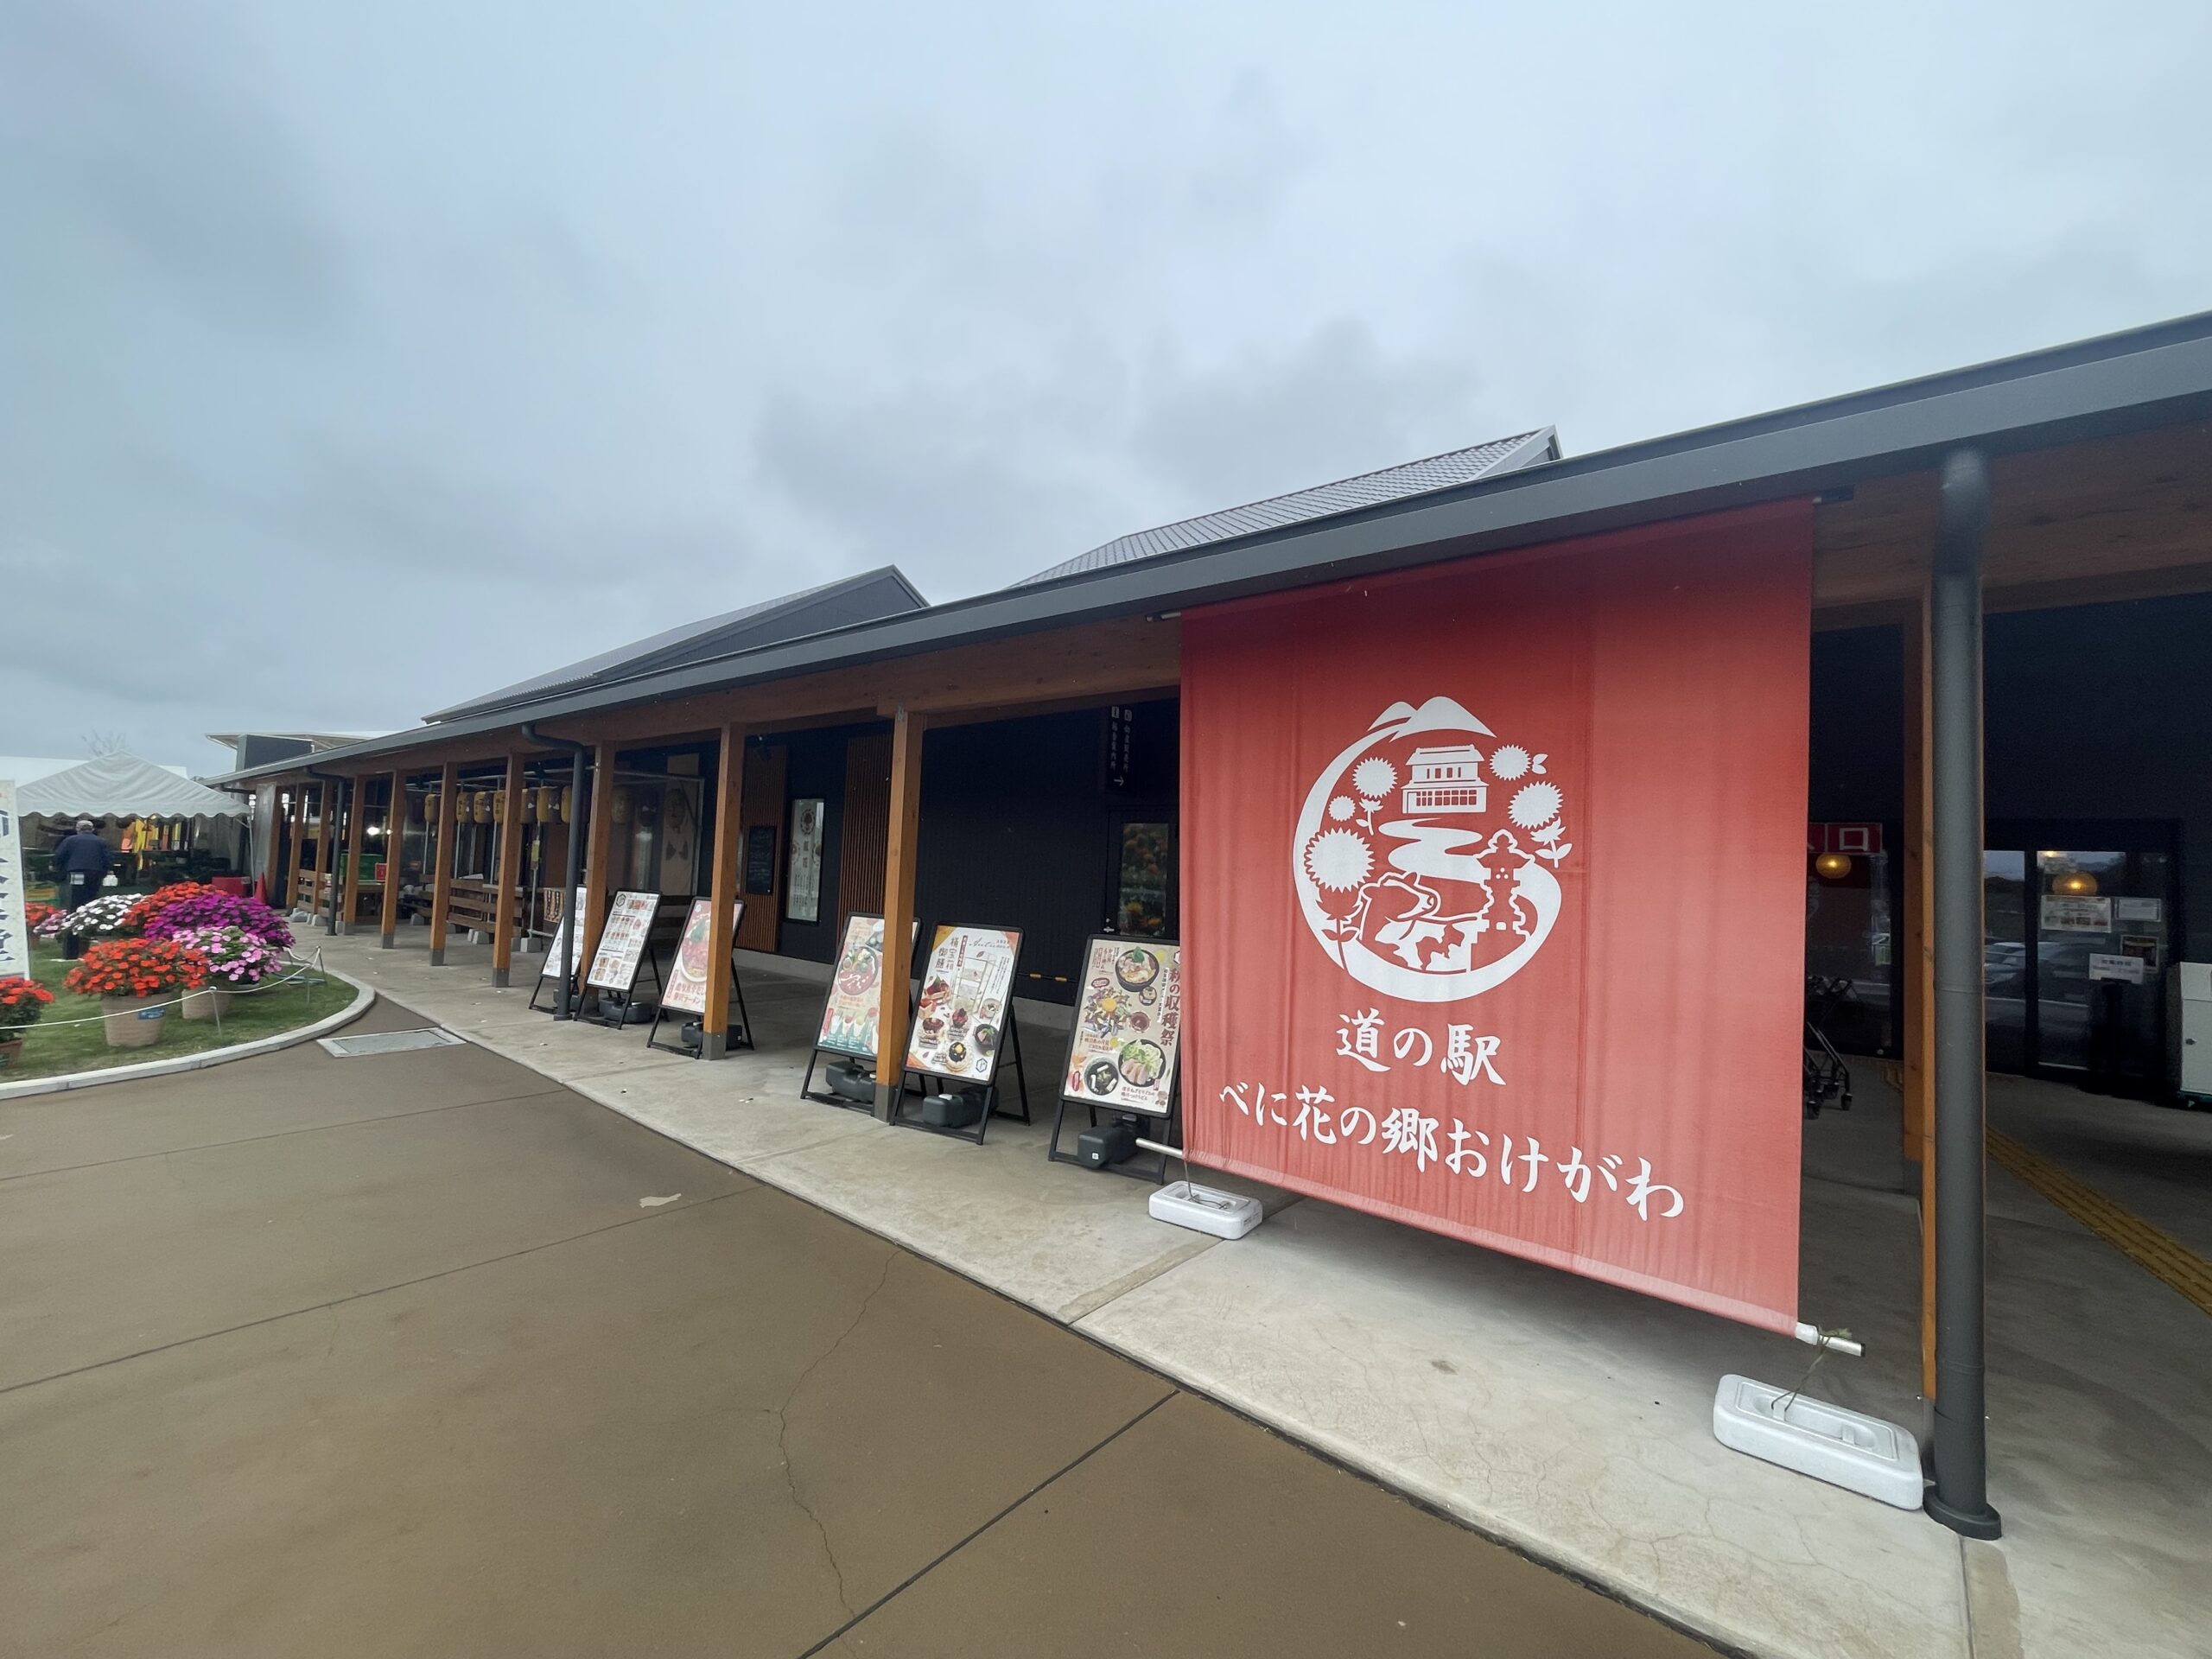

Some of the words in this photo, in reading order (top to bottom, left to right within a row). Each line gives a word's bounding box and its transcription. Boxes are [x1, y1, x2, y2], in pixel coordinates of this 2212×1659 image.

[1336, 1007, 1506, 1086] 道の駅
[1218, 1081, 1684, 1222] べに花の郷おけがわ
